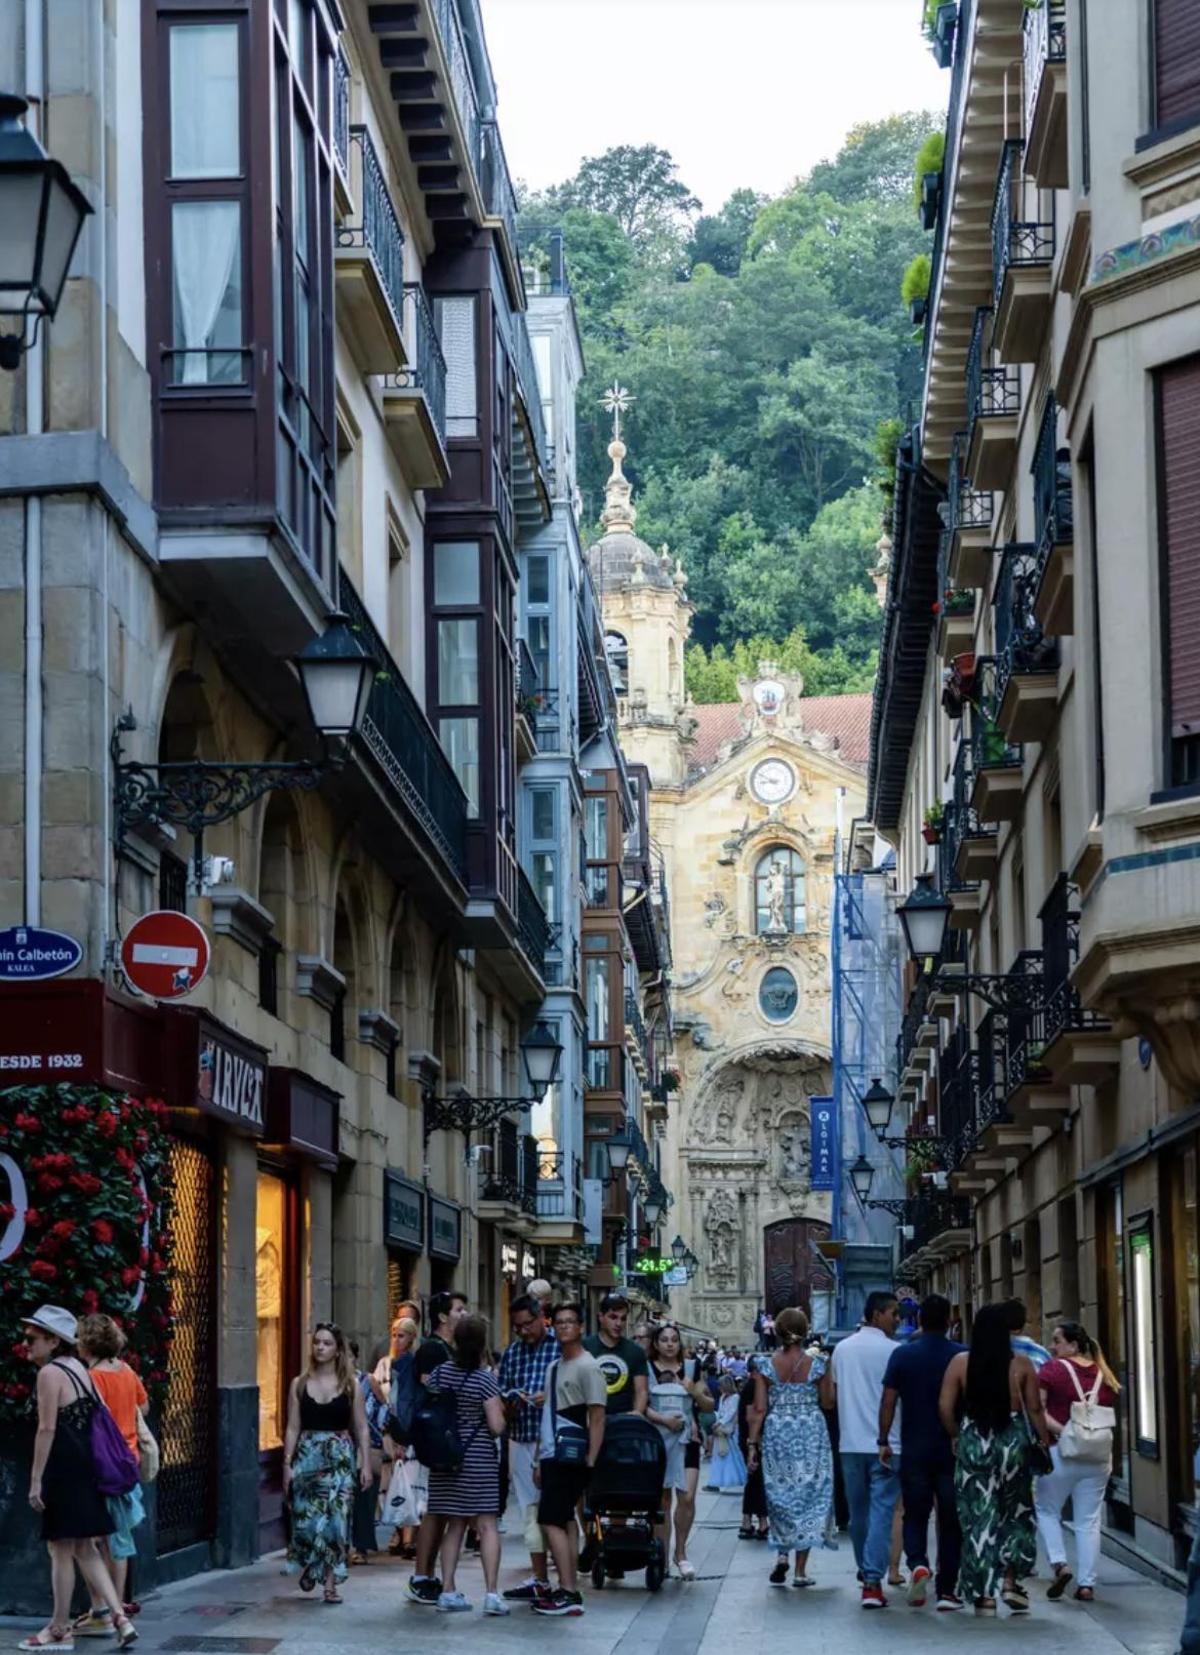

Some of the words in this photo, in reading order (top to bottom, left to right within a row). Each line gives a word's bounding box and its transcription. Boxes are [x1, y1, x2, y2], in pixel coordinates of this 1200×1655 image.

[18, 948, 73, 960] Calbetón
[8, 964, 35, 972] KALEA
[48, 1054, 83, 1068] 1932
